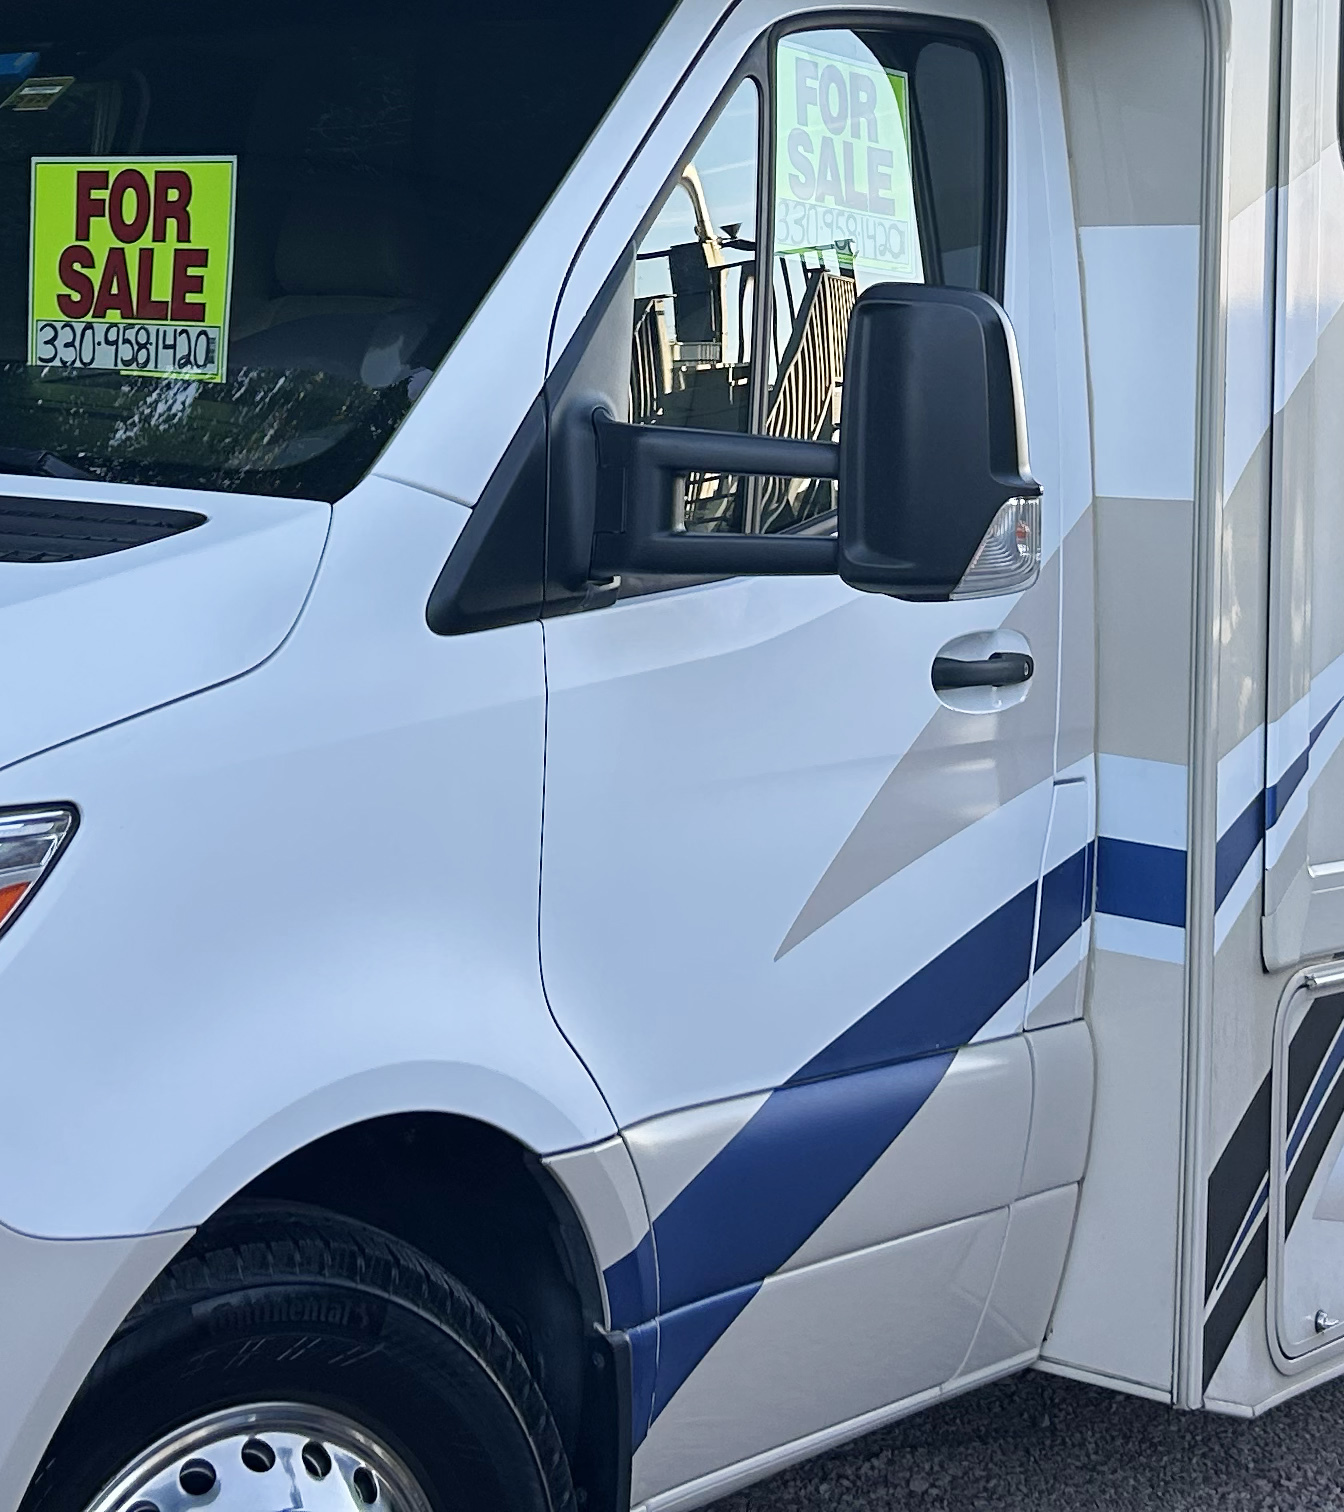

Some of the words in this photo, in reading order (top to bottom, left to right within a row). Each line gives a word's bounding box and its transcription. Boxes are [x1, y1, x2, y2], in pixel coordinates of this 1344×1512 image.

[796, 57, 878, 143] FOR
[75, 168, 192, 243] FOR
[788, 129, 894, 215] SALE
[56, 245, 209, 321] SALE
